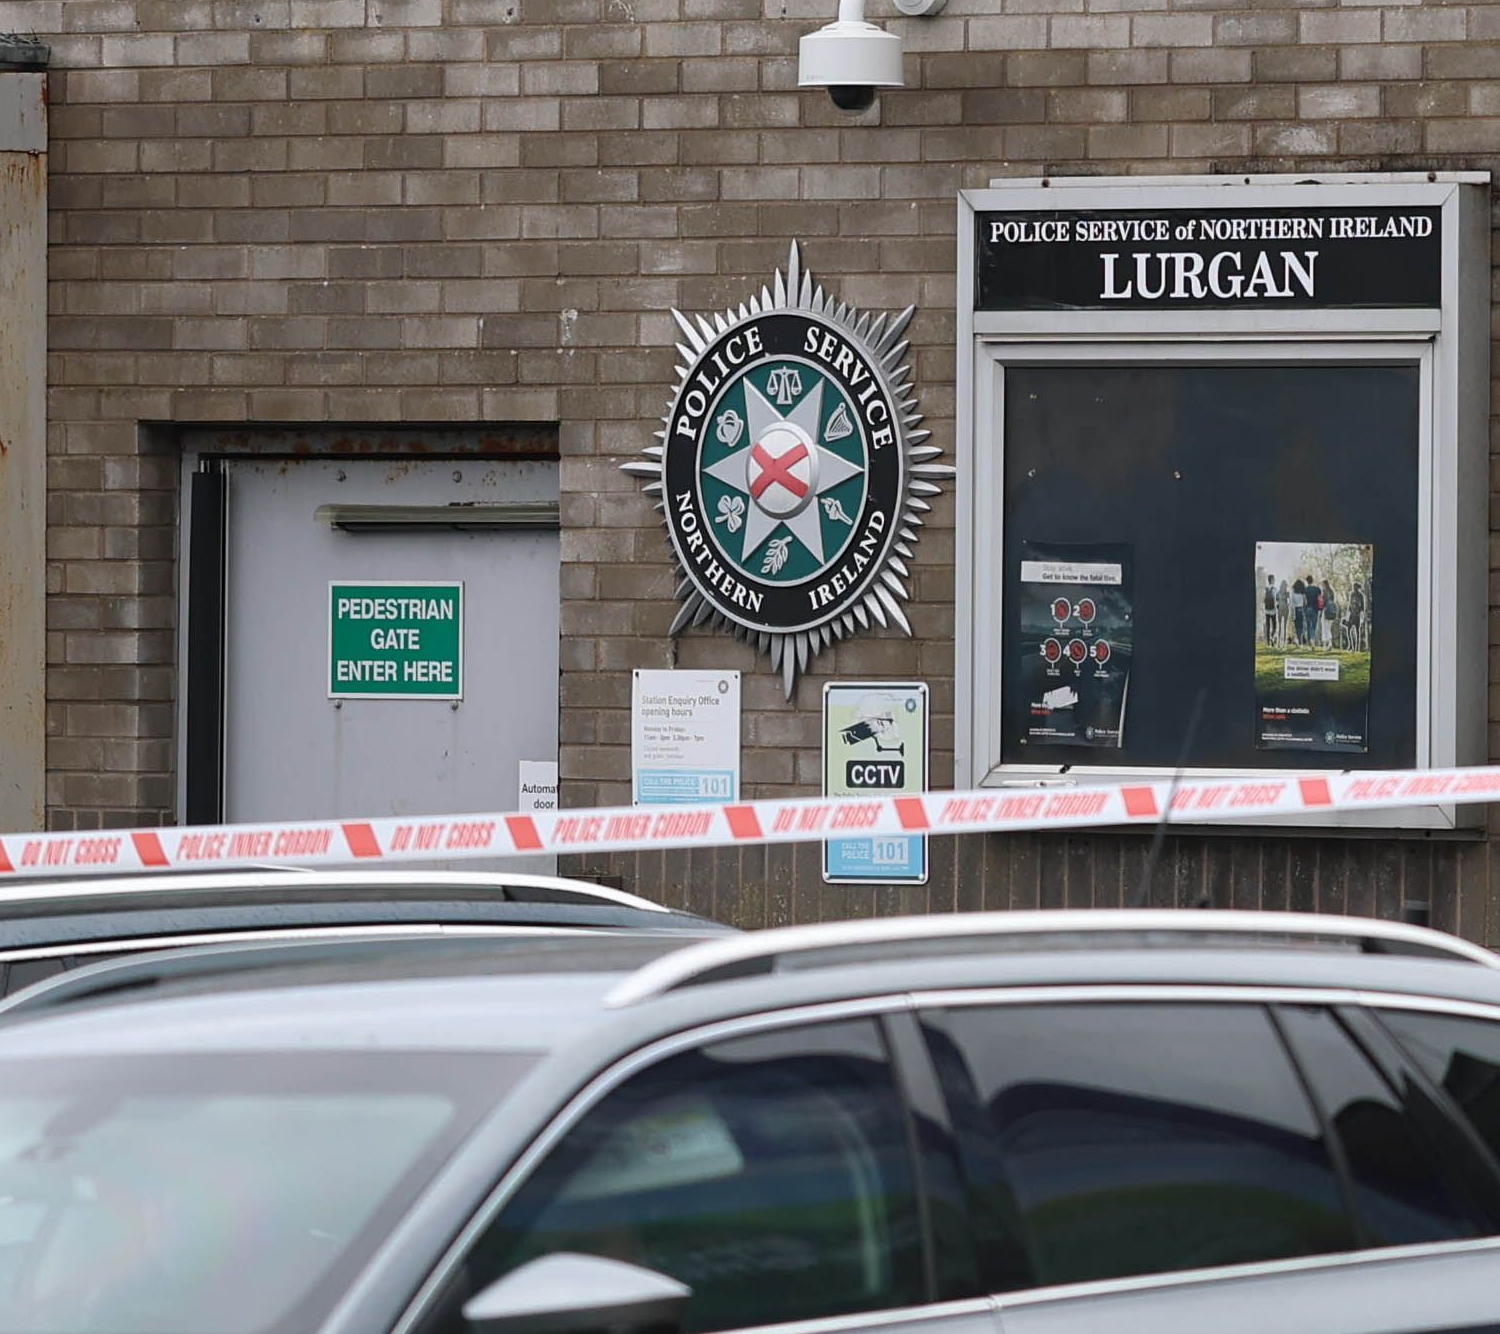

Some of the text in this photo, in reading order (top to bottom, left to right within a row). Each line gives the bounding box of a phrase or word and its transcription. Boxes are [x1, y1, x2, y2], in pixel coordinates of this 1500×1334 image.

[990, 216, 1432, 243] POLICE SERVICE of NORTHERN IRELAND
[1100, 251, 1319, 299] LURGAN
[676, 326, 893, 450] POLICE SERVICE
[676, 490, 885, 613] NORTHERN IRELAND
[338, 598, 453, 620] PEDESTRIAN
[370, 628, 420, 650] GATE
[337, 660, 453, 682] ENTER HERE
[642, 696, 720, 706] Station Enquiry Office
[641, 707, 693, 718] opening hours
[702, 777, 728, 795] 101
[851, 765, 900, 785] CCTV
[521, 782, 557, 794] Automa
[534, 798, 555, 809] door
[176, 830, 332, 859] POLICE INNER CORDON
[391, 823, 496, 851] DO NOT CROSS
[20, 838, 122, 866] DO NOT CROSS
[876, 842, 906, 860] 101
